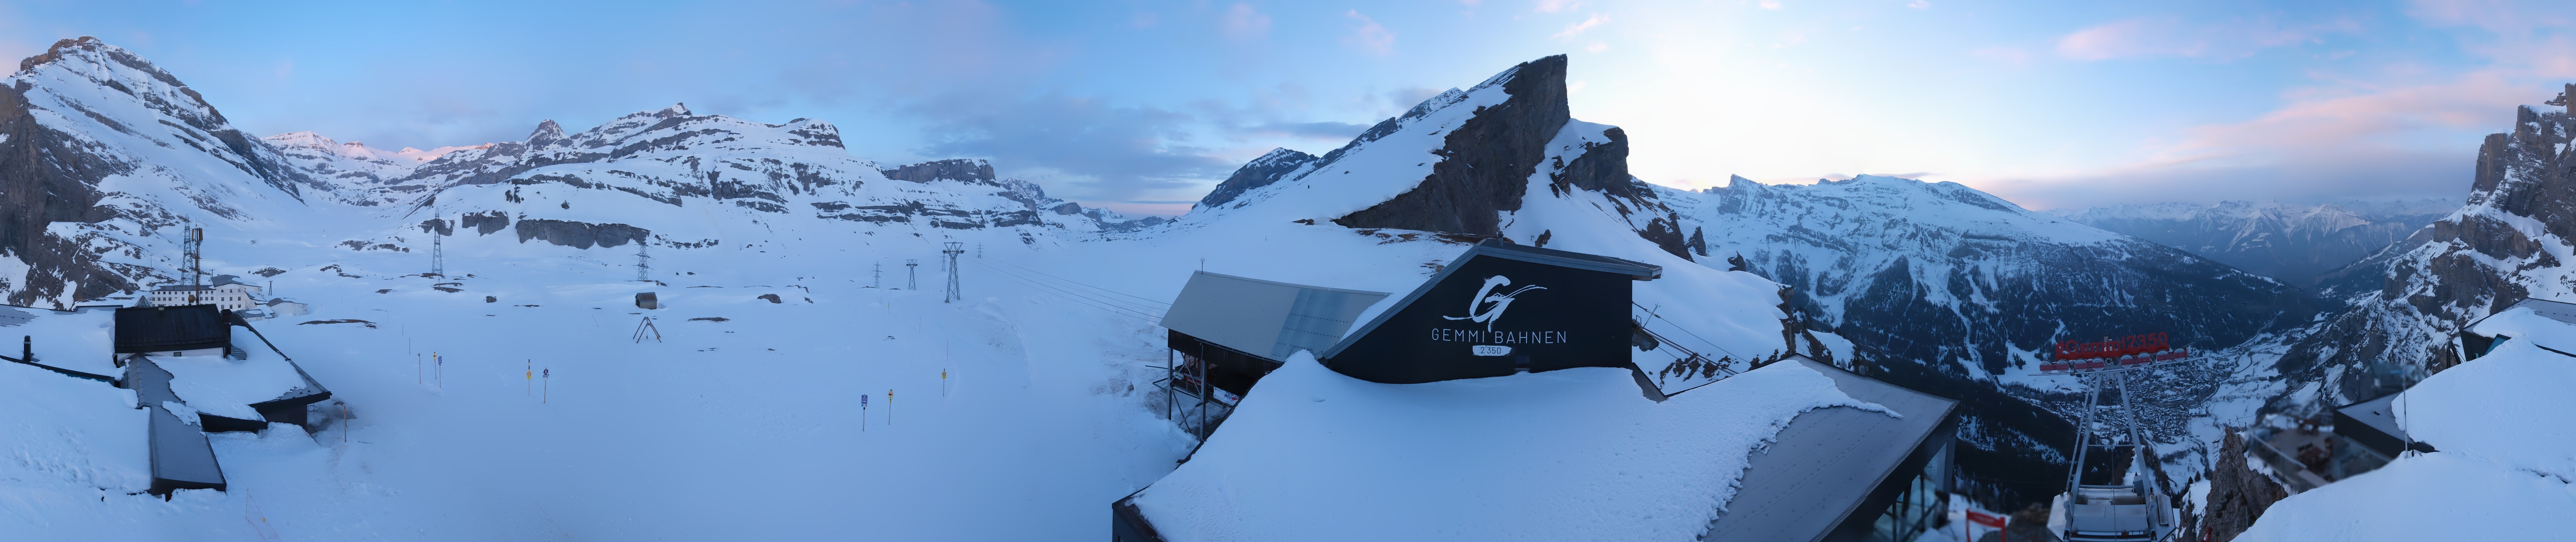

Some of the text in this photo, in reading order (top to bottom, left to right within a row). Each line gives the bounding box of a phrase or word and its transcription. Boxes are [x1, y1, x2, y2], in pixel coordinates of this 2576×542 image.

[1432, 328, 1566, 344] GEMMI BAHNEN
[2055, 332, 2168, 354] #Gemmi2350
